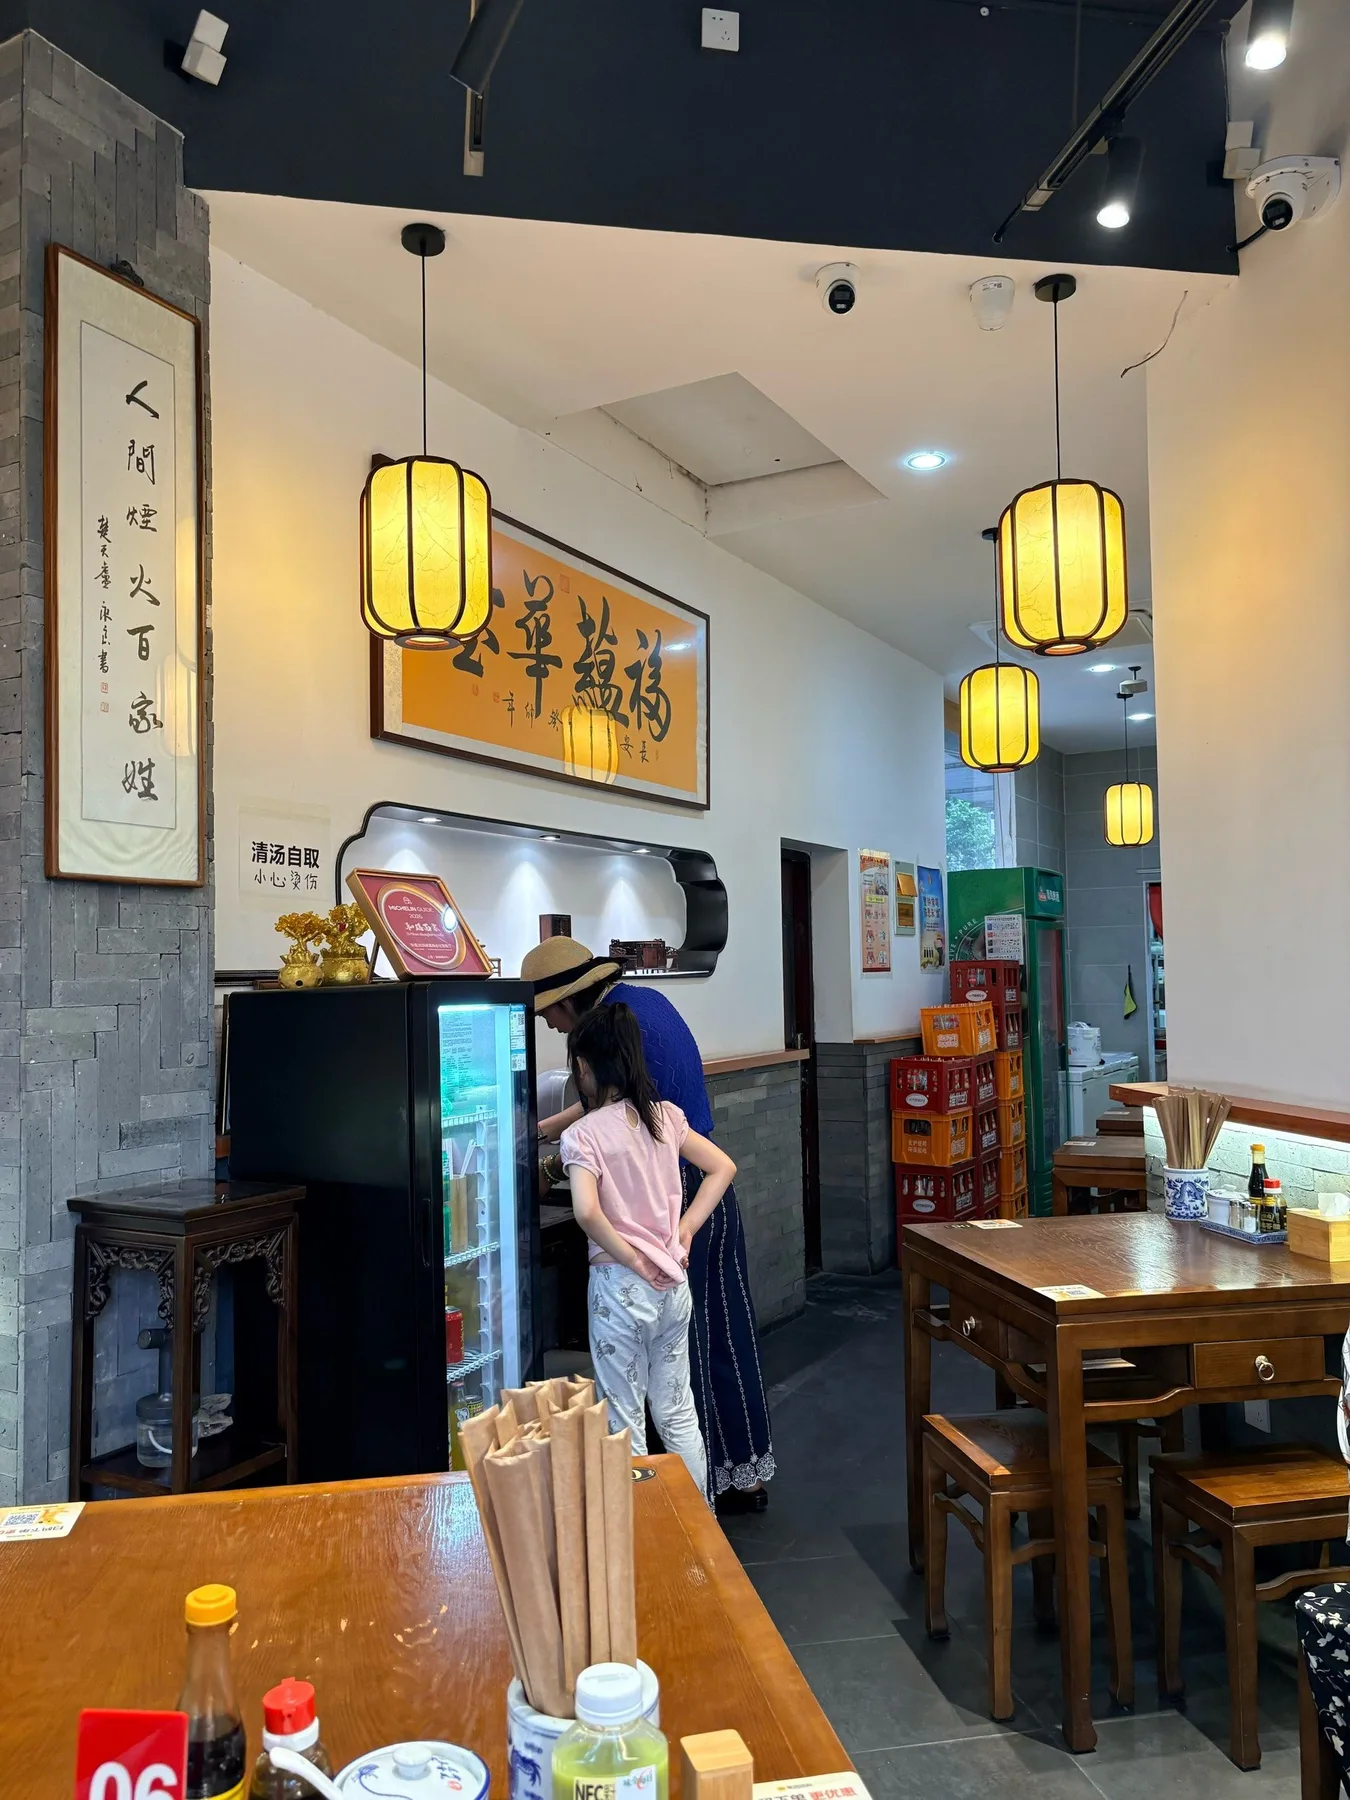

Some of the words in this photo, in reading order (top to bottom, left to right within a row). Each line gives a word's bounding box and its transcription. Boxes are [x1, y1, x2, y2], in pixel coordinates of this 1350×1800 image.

[251, 841, 320, 869] 清汤自取
[254, 868, 319, 890] 小心烫伤
[958, 917, 978, 935] PURE
[89, 1761, 178, 1800] 06
[575, 1783, 604, 1800] NFC
